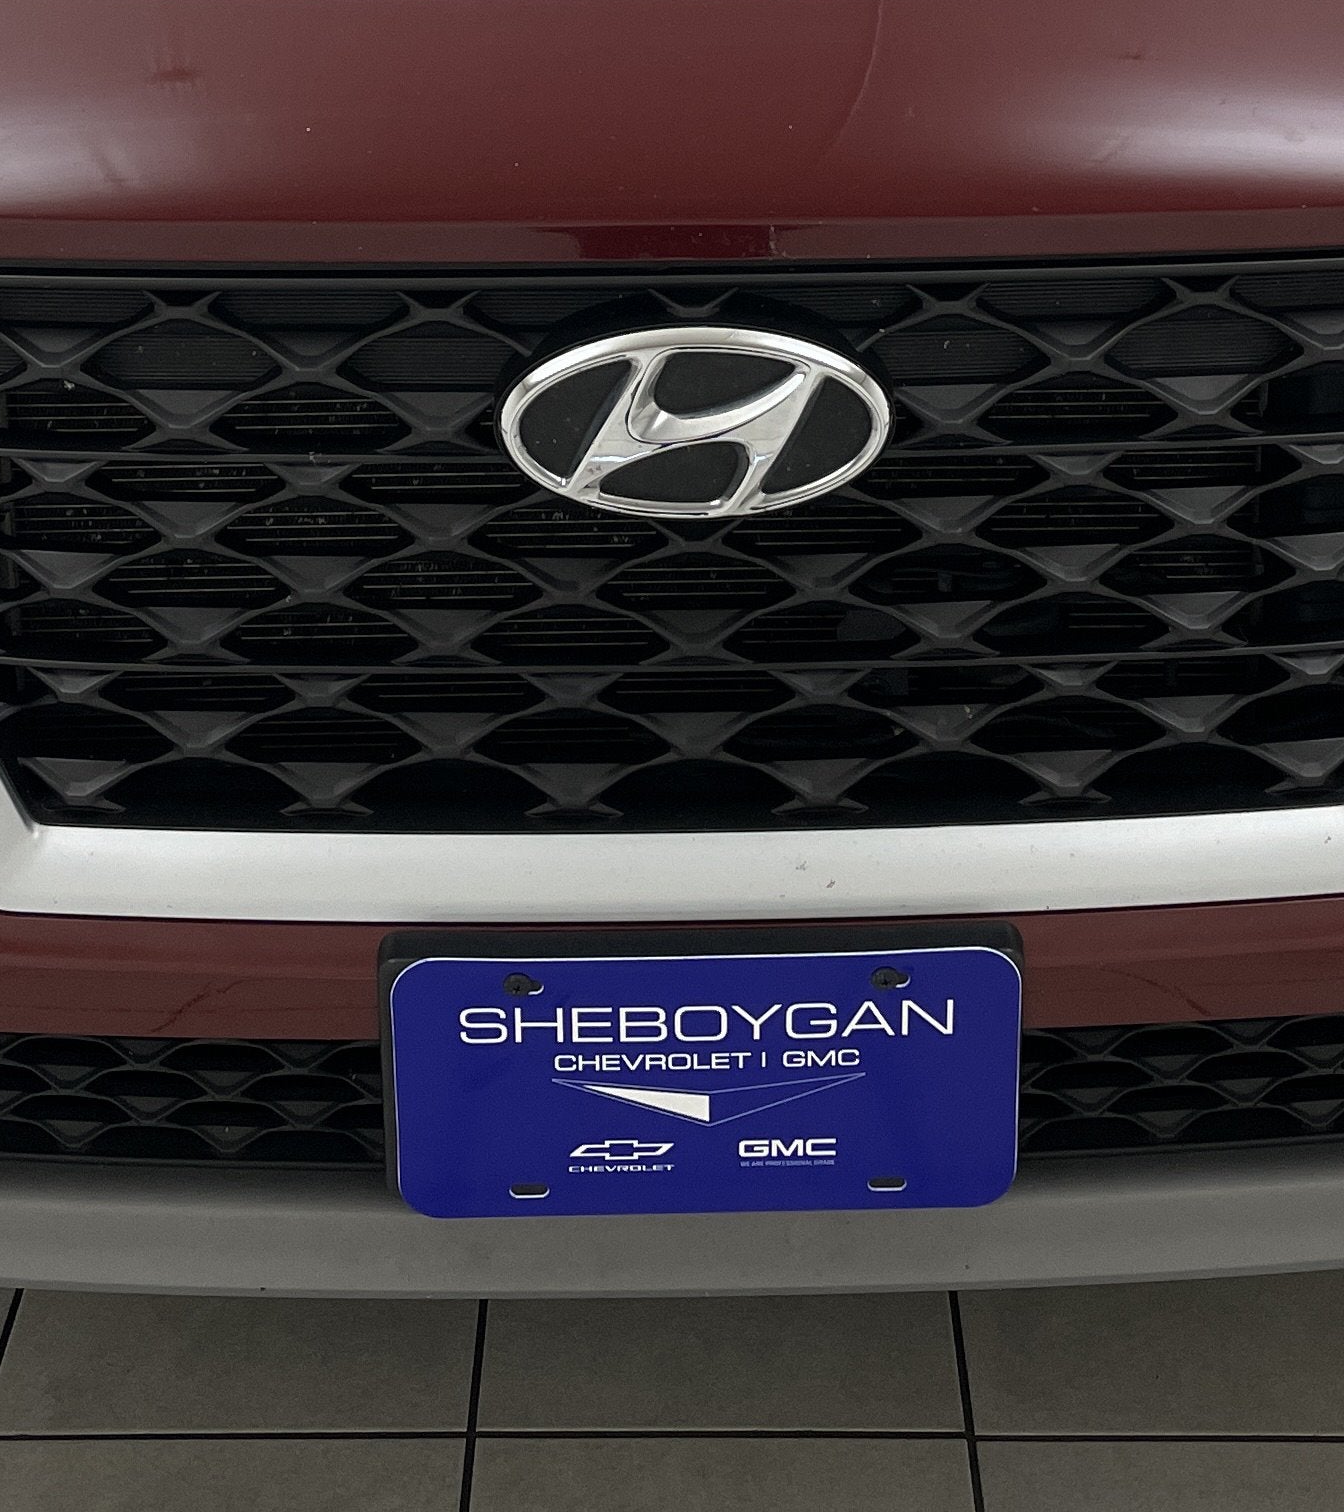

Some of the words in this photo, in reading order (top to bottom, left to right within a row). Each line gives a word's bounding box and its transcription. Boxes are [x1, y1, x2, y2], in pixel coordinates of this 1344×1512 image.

[458, 999, 955, 1045] SHEBOYGAN
[553, 1051, 752, 1073] CHEVROLET
[782, 1049, 860, 1069] GMC
[738, 1138, 837, 1158] GMC
[568, 1164, 675, 1173] CHEVROLET
